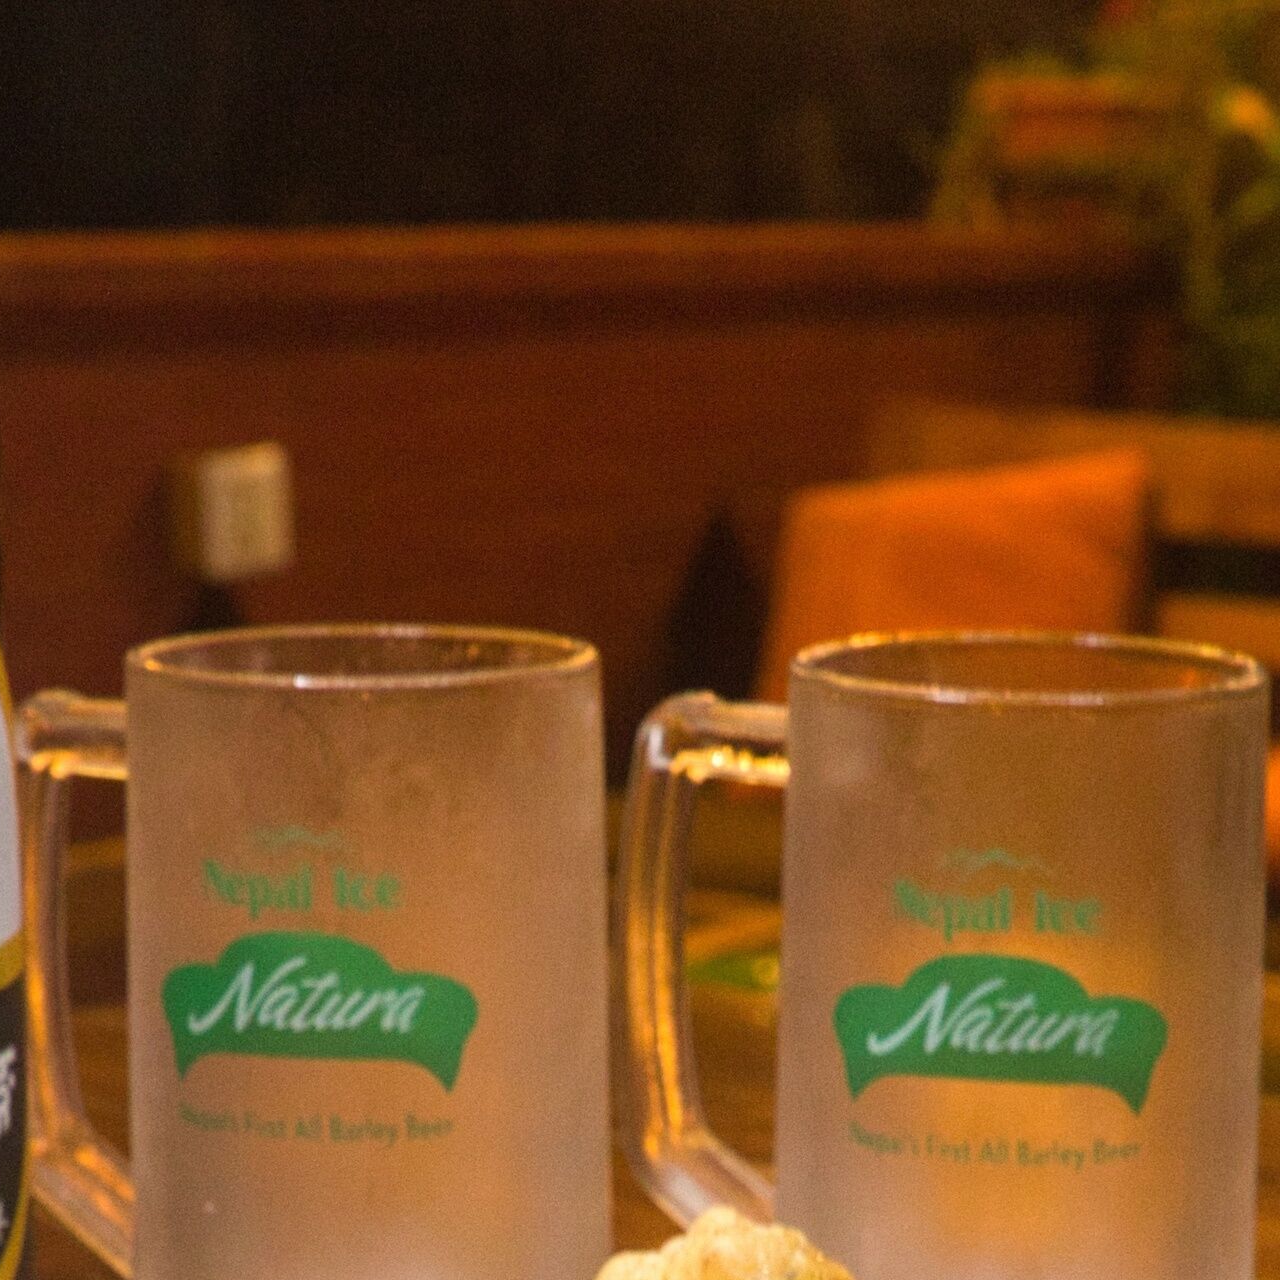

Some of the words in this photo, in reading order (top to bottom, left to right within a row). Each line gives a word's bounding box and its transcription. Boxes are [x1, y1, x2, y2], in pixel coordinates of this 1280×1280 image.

[203, 858, 312, 920] Nepal
[332, 864, 402, 911] Ice
[892, 878, 1011, 944] Nepal
[1034, 889, 1103, 935] Ice
[187, 955, 425, 1034] Natura
[867, 976, 1119, 1056] Natura
[329, 1114, 397, 1147] Barley
[405, 1113, 453, 1139] Beer
[979, 1138, 1008, 1164] All
[1016, 1139, 1085, 1172] Barley
[1093, 1139, 1141, 1164] Beer
